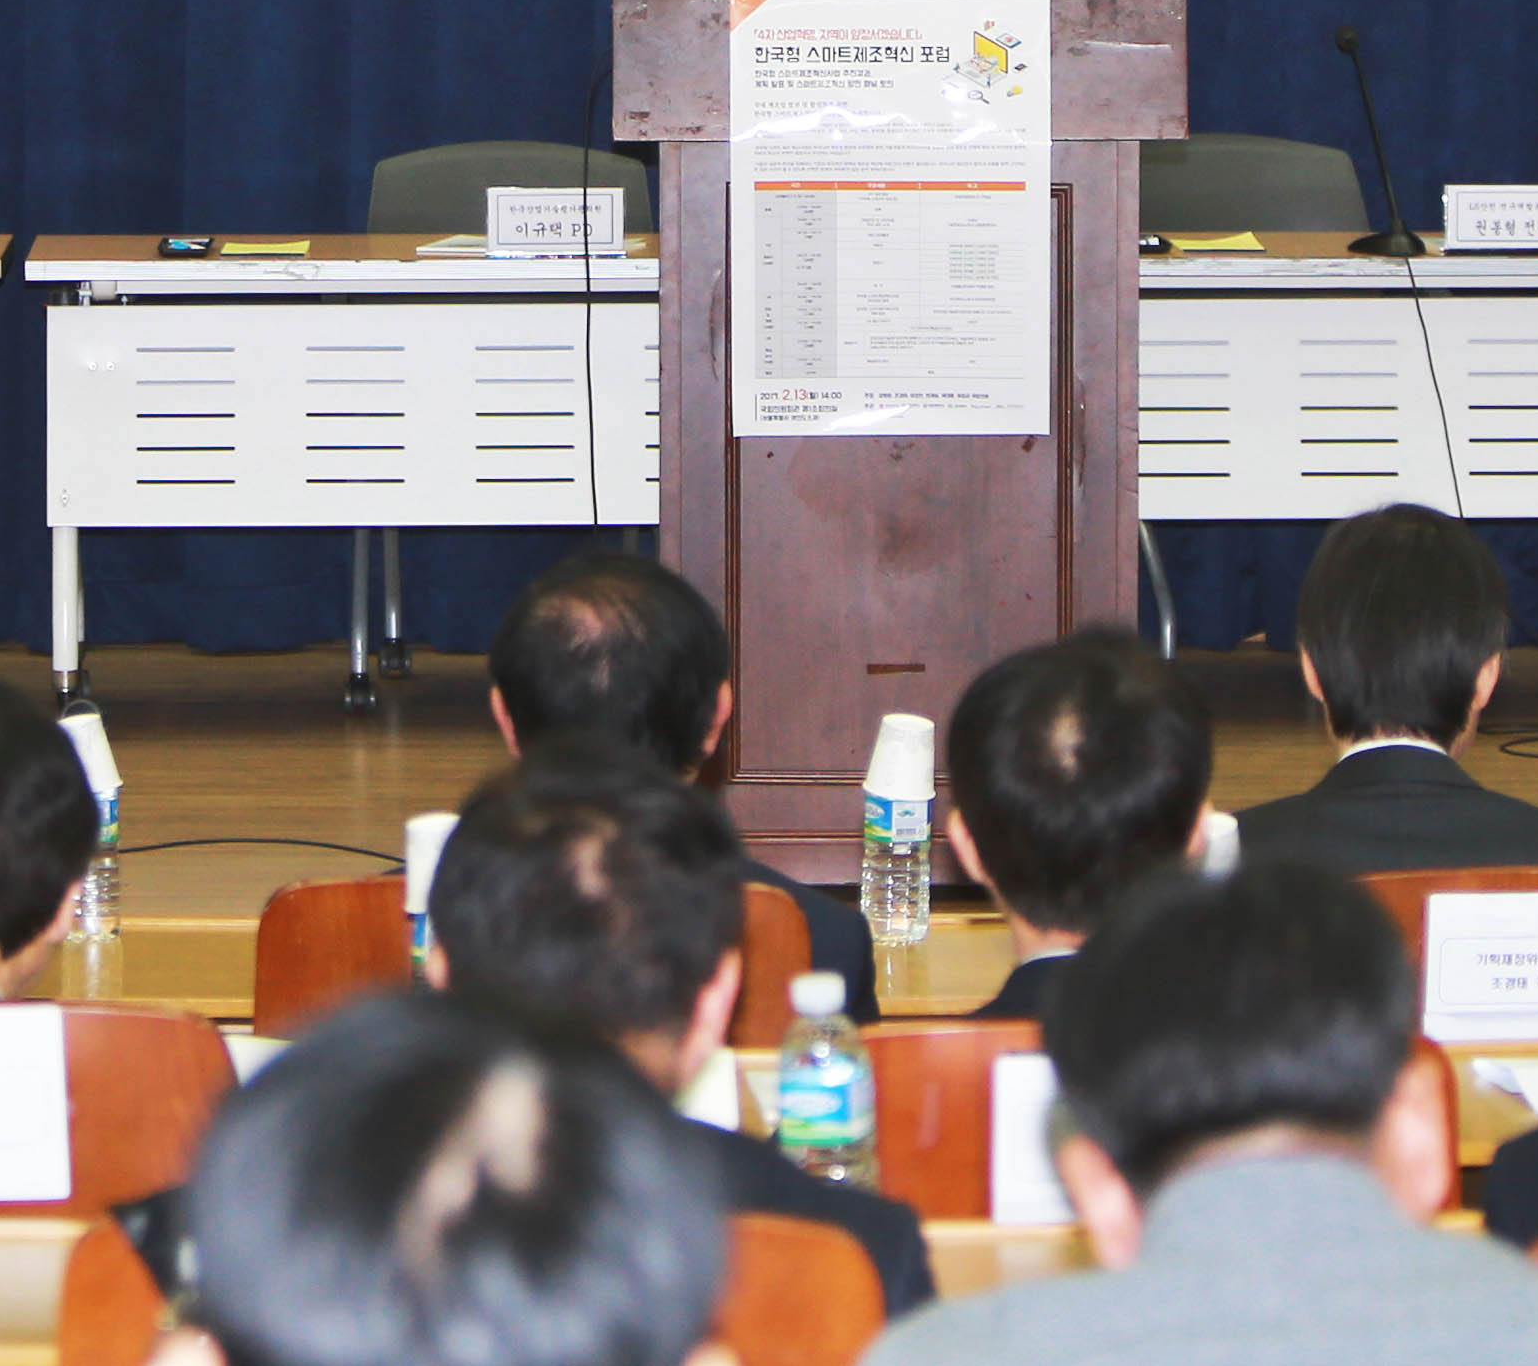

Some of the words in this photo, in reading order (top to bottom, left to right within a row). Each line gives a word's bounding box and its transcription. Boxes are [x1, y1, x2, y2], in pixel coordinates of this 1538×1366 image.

[754, 46, 800, 63] 한국형
[806, 46, 914, 63] 스마트제조혁신
[920, 46, 950, 63] 포럼
[515, 222, 562, 238] 이규택
